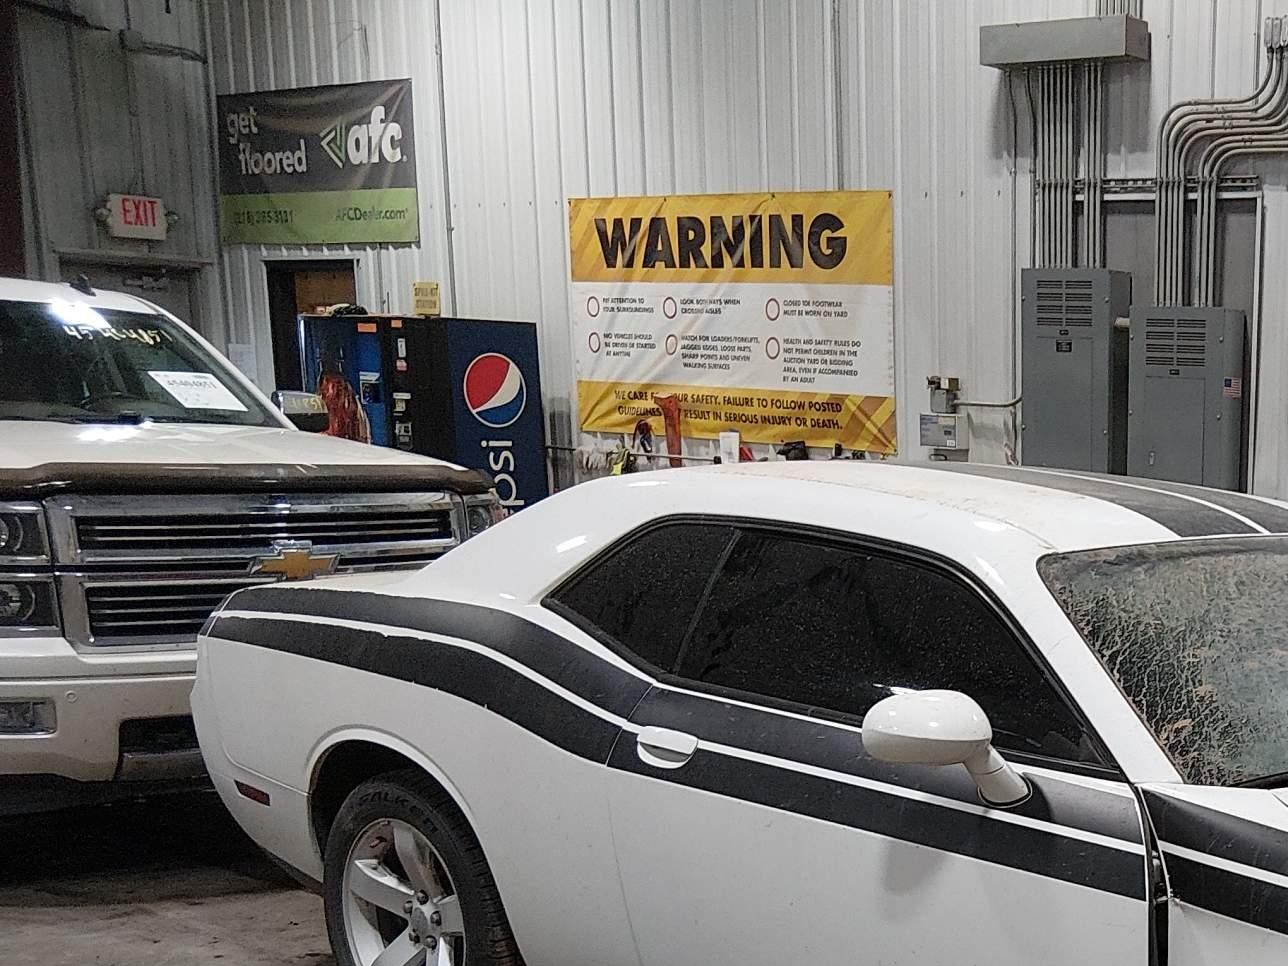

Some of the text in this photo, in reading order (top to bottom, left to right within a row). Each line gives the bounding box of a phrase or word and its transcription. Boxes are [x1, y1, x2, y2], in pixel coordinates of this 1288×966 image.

[226, 105, 258, 144] get
[347, 105, 402, 164] afc
[239, 138, 307, 175] floored
[122, 198, 157, 227] EXIT
[594, 213, 848, 270] WARNING
[812, 300, 842, 308] FOOTWEAR
[818, 368, 858, 376] ACCOMPANIED
[614, 390, 626, 400] WE
[627, 390, 648, 401] CARE
[691, 394, 721, 405] SAFETY.
[723, 396, 755, 407] FAILURE
[756, 398, 768, 408] TO
[770, 399, 805, 410] FOLLOW
[809, 401, 843, 413] POSTED
[618, 405, 662, 416] GUIDELINES
[685, 409, 711, 420] RESULT
[712, 411, 722, 421] IN
[724, 412, 759, 424] SERIOUS
[760, 414, 792, 426] INJURY
[795, 417, 808, 428] OR
[811, 418, 843, 429] DEATH.
